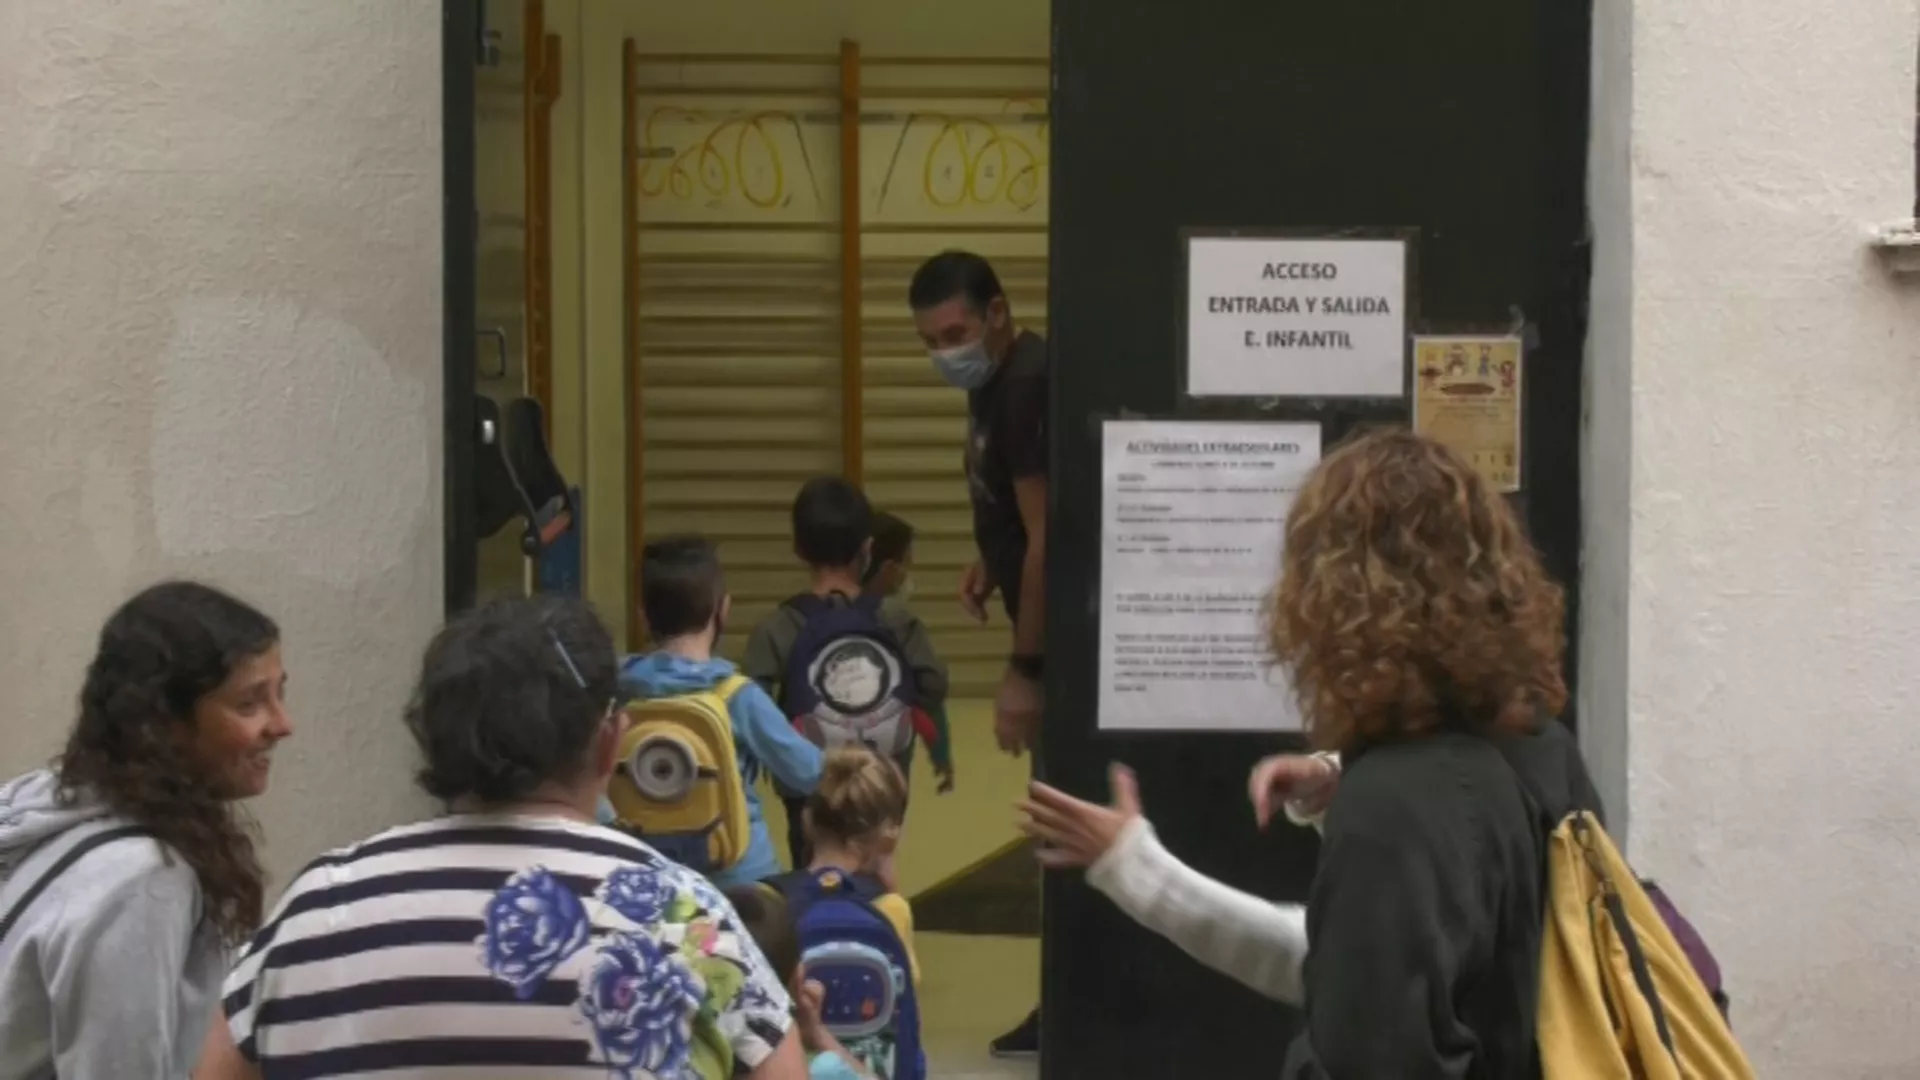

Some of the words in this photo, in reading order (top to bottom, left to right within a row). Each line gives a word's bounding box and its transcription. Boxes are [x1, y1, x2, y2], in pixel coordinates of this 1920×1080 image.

[1261, 261, 1338, 280] ACCESO
[1208, 296, 1300, 316] ENTRADA
[1305, 296, 1317, 315] Y
[1321, 296, 1391, 315] SALIDA
[1244, 330, 1260, 348] E.
[1265, 330, 1353, 349] INFANTIL
